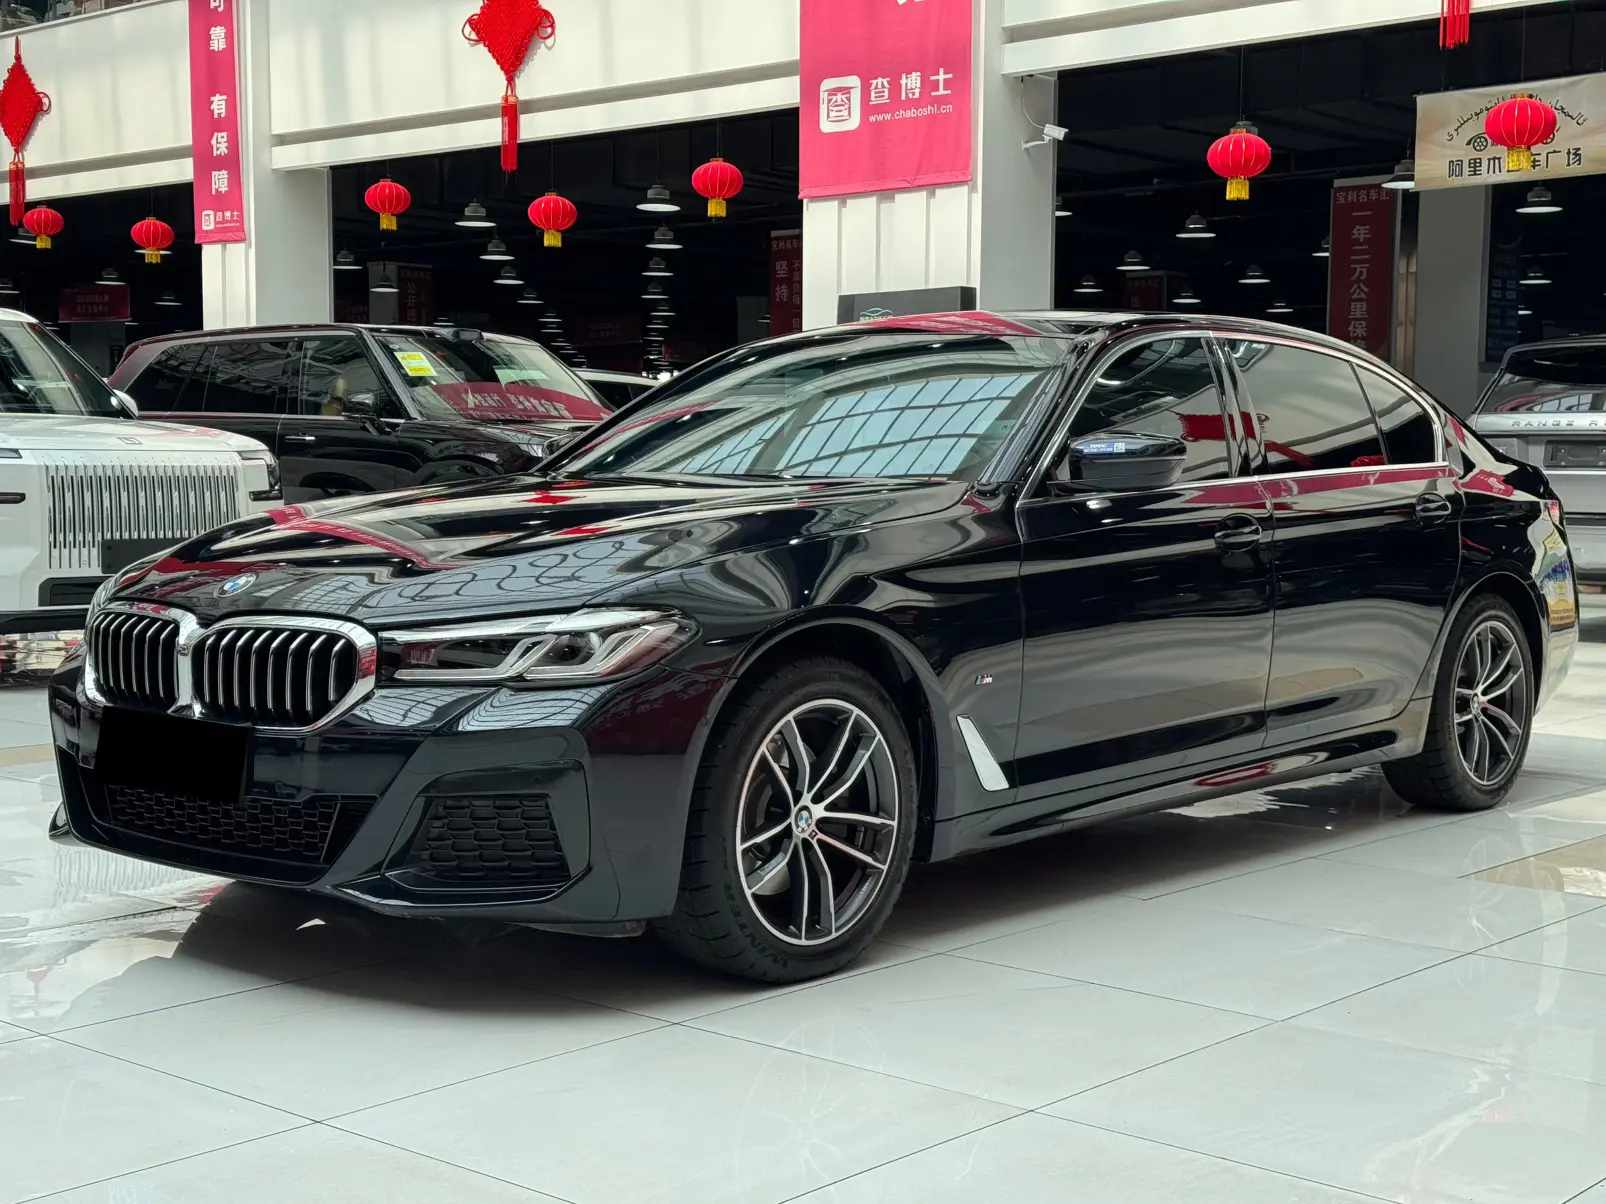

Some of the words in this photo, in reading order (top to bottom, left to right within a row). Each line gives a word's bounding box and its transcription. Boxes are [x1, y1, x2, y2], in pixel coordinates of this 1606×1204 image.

[868, 68, 954, 105] 查博士
[210, 93, 229, 195] 有保障
[1447, 147, 1582, 178] 阿里木车广场
[1335, 188, 1390, 204] 宝利名车汇
[775, 260, 789, 302] 坚持
[1512, 419, 1575, 427] RANGE
